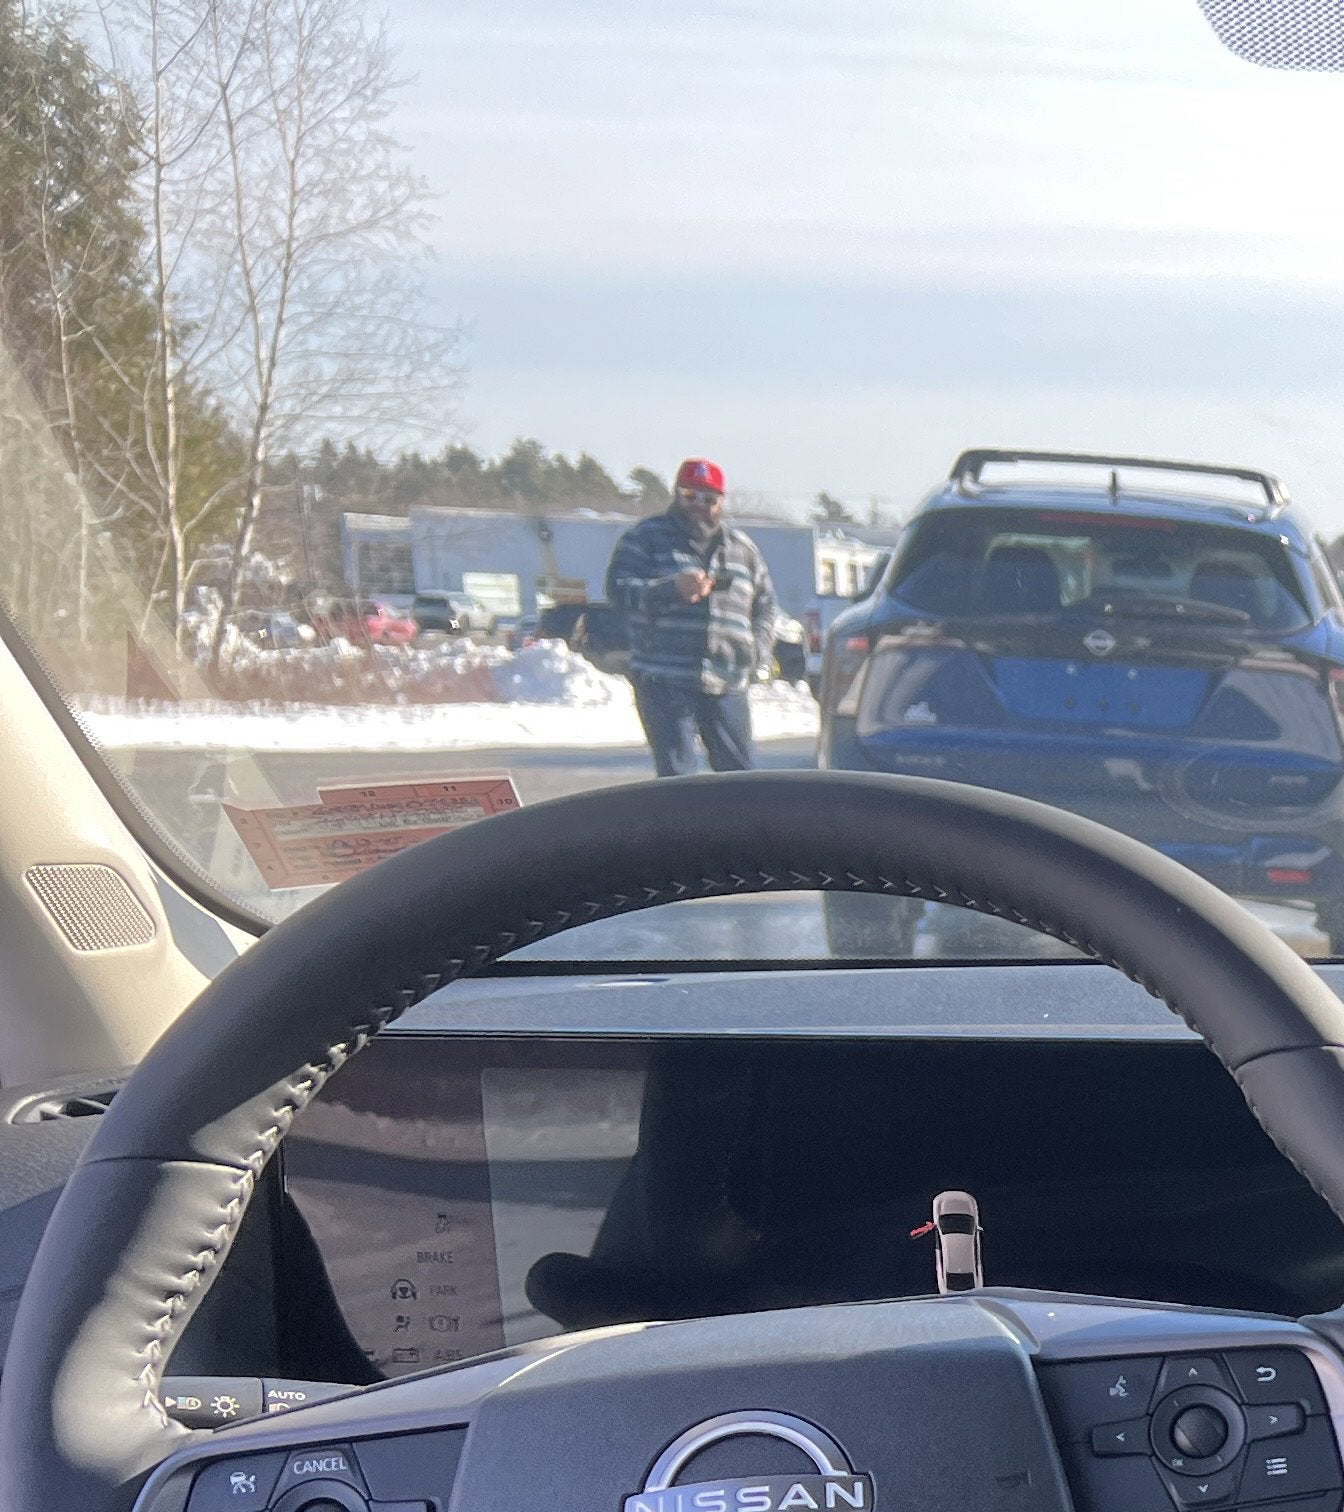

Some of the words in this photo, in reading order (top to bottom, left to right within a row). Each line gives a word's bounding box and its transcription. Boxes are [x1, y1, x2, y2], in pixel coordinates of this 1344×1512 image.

[416, 1251, 454, 1264] BRAKE
[267, 1389, 306, 1401] AUTO
[293, 1457, 347, 1475] CANCEL
